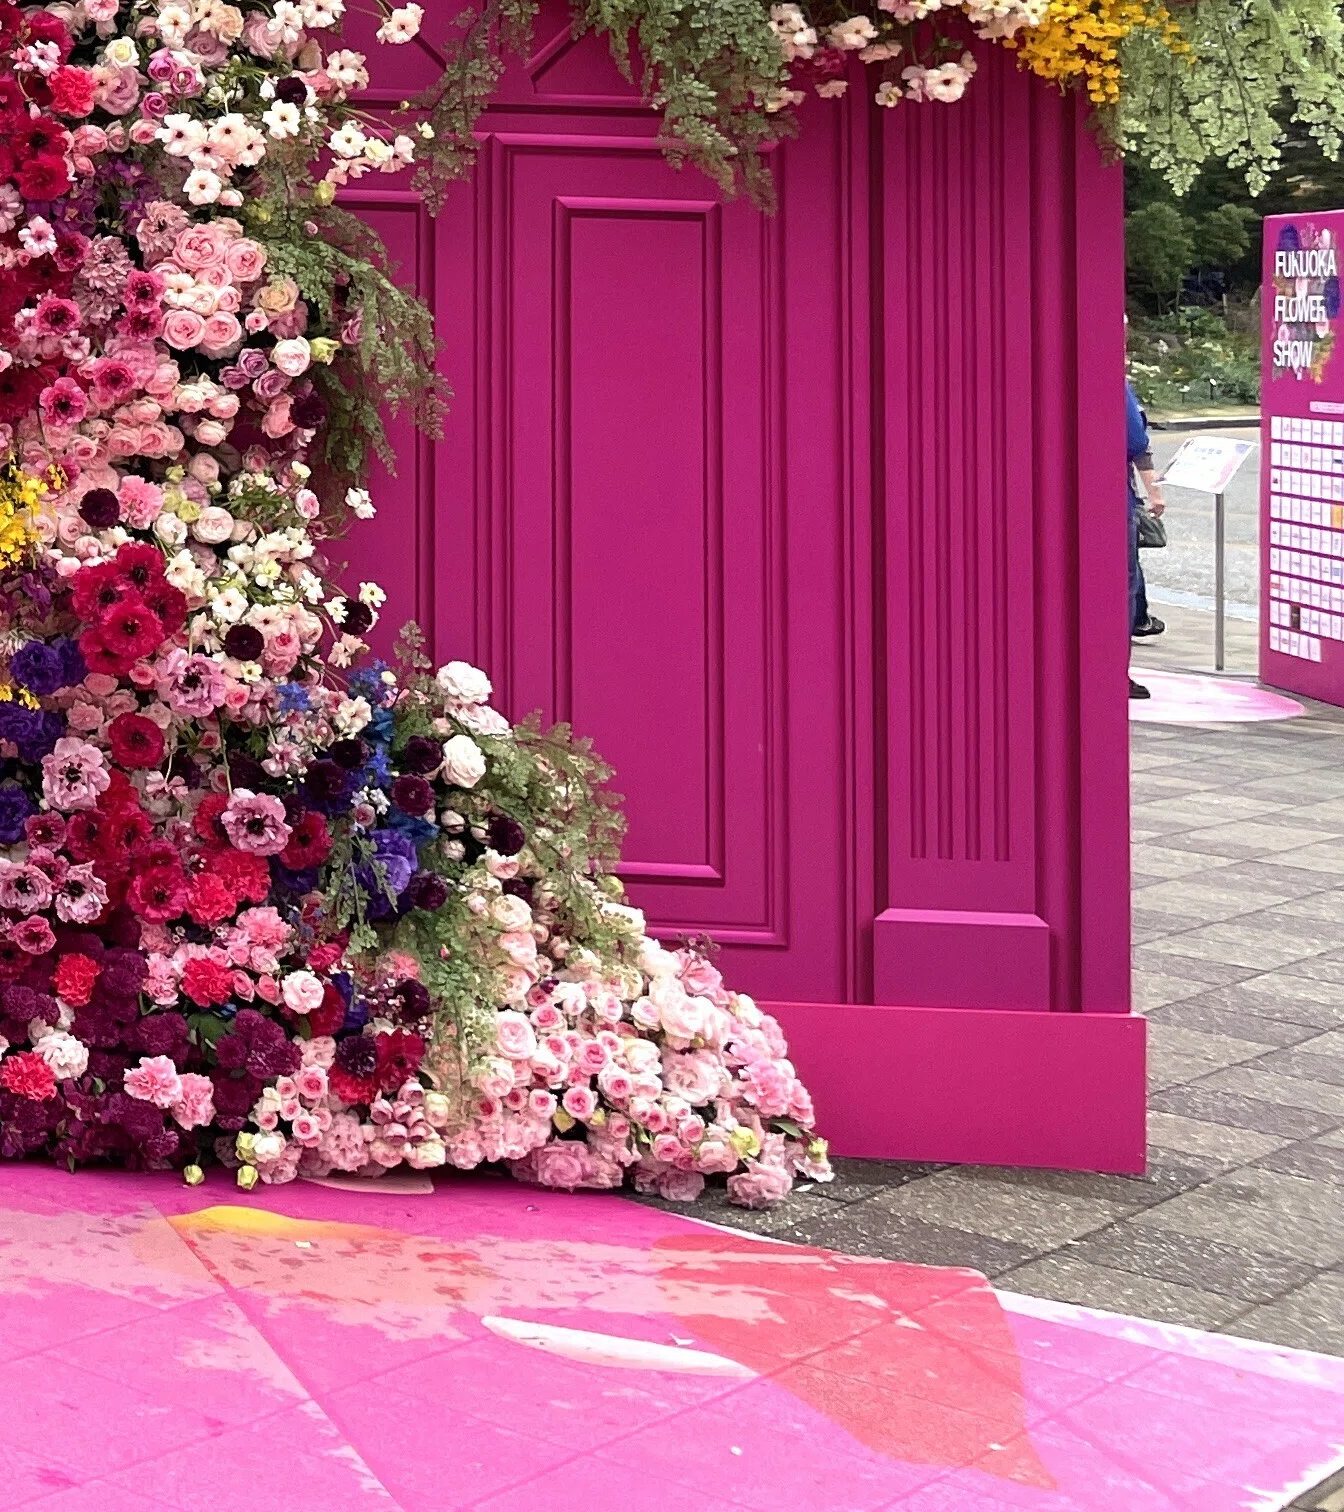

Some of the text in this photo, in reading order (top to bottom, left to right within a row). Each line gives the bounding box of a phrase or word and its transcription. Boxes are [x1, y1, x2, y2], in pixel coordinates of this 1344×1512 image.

[1275, 249, 1337, 278] FUKUOKA
[1274, 295, 1326, 322] FLOWER
[1273, 340, 1313, 367] SHOW
